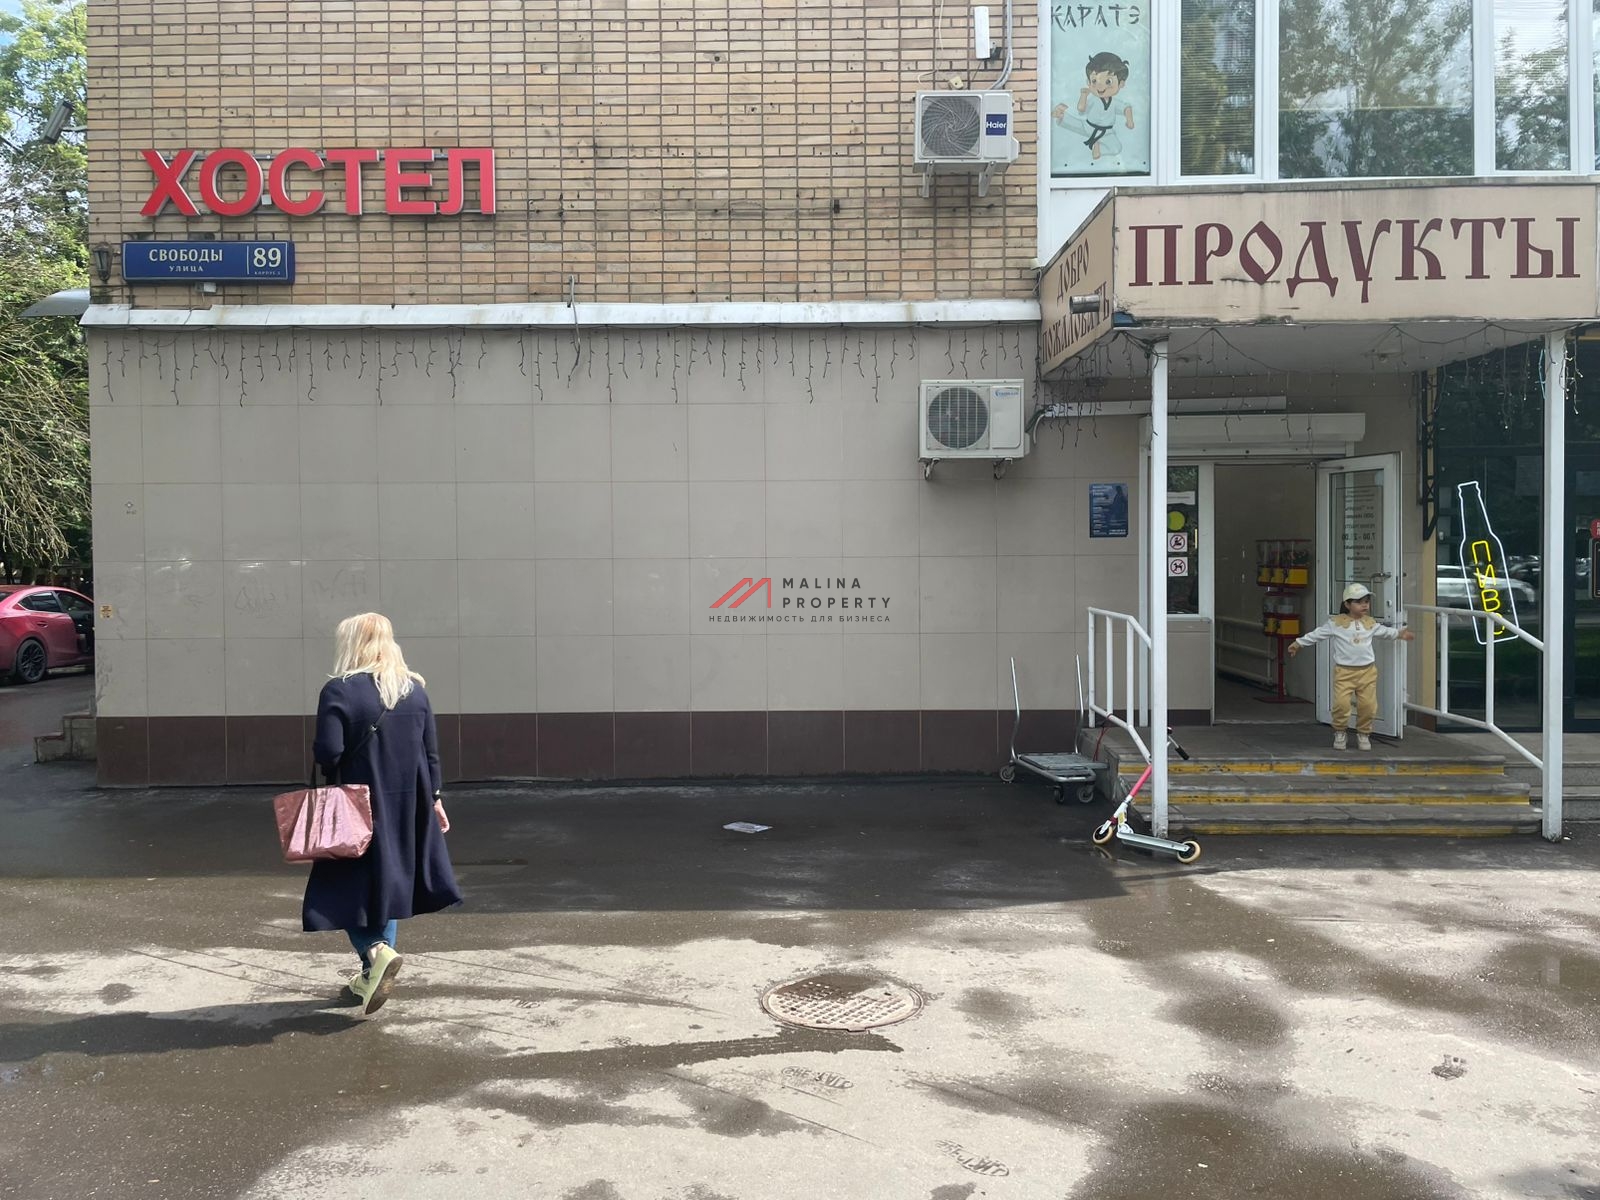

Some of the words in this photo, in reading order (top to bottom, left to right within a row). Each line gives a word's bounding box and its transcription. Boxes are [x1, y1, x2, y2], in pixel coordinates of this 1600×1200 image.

[1050, 4, 1140, 32] КАРАТЭ
[986, 121, 1007, 129] Haier
[140, 148, 496, 217] ХОСТЕЛ
[149, 249, 223, 262] СВОБОДЫ
[253, 247, 282, 268] 89
[1128, 217, 1581, 303] ПРОДУКТЫ
[169, 265, 204, 273] УЛИЦА
[1056, 237, 1089, 305] ДОБРО
